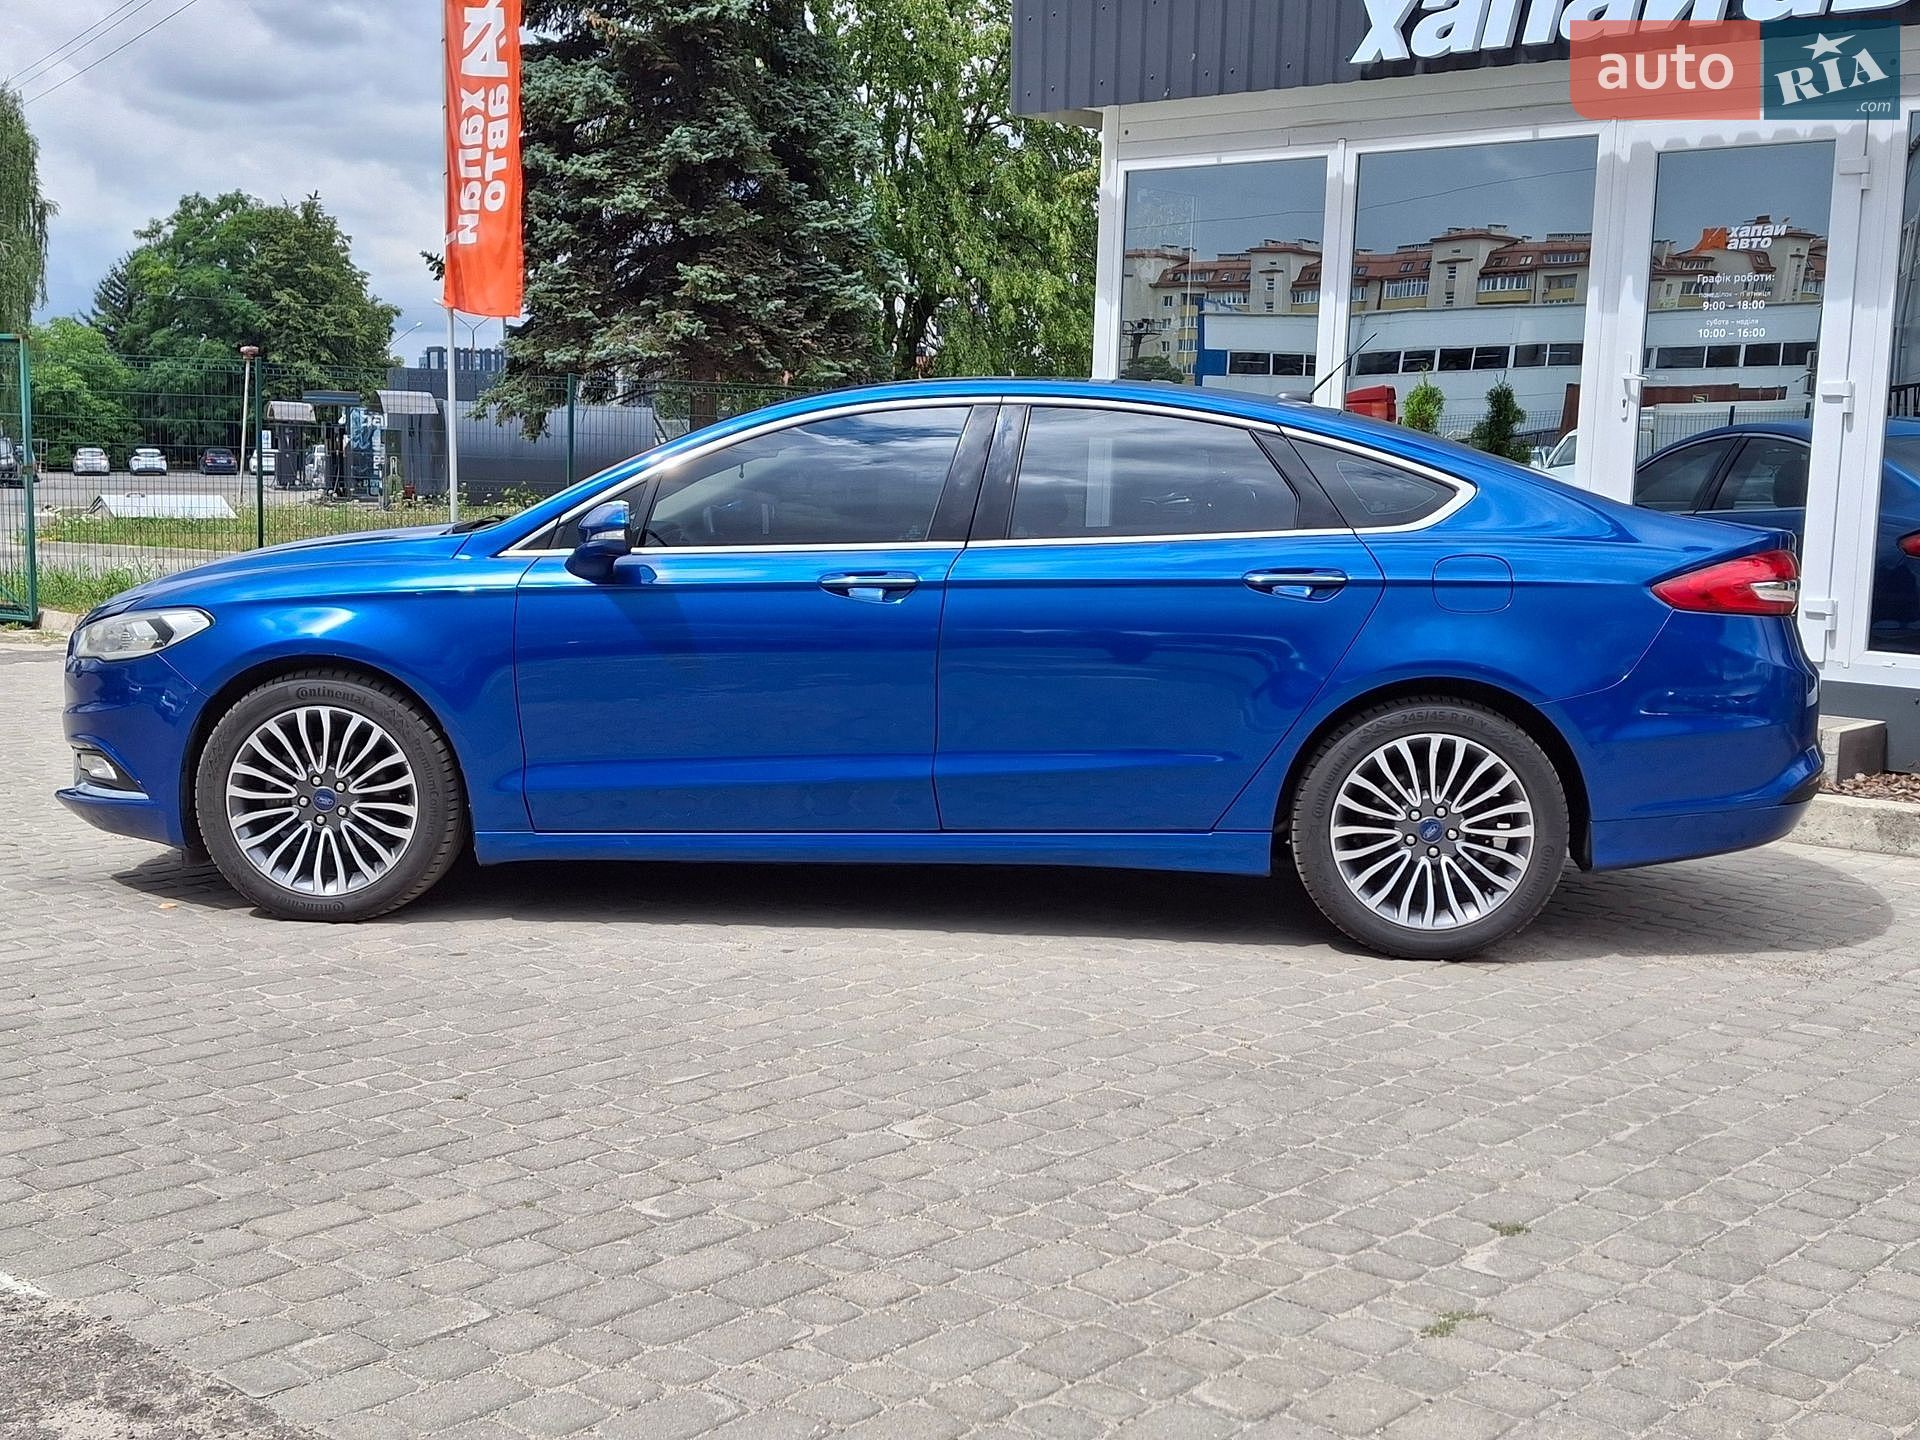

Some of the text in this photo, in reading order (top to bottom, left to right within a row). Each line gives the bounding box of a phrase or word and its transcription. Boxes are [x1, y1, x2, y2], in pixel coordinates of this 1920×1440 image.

[1727, 237, 1773, 250] авто
[1697, 272, 1775, 285] Графік роботи:
[1703, 300, 1726, 311] 9:00
[1737, 299, 1766, 310] 18:00
[1698, 328, 1726, 338] 10:00
[1737, 327, 1766, 338] 16:00
[296, 682, 367, 706] Continental
